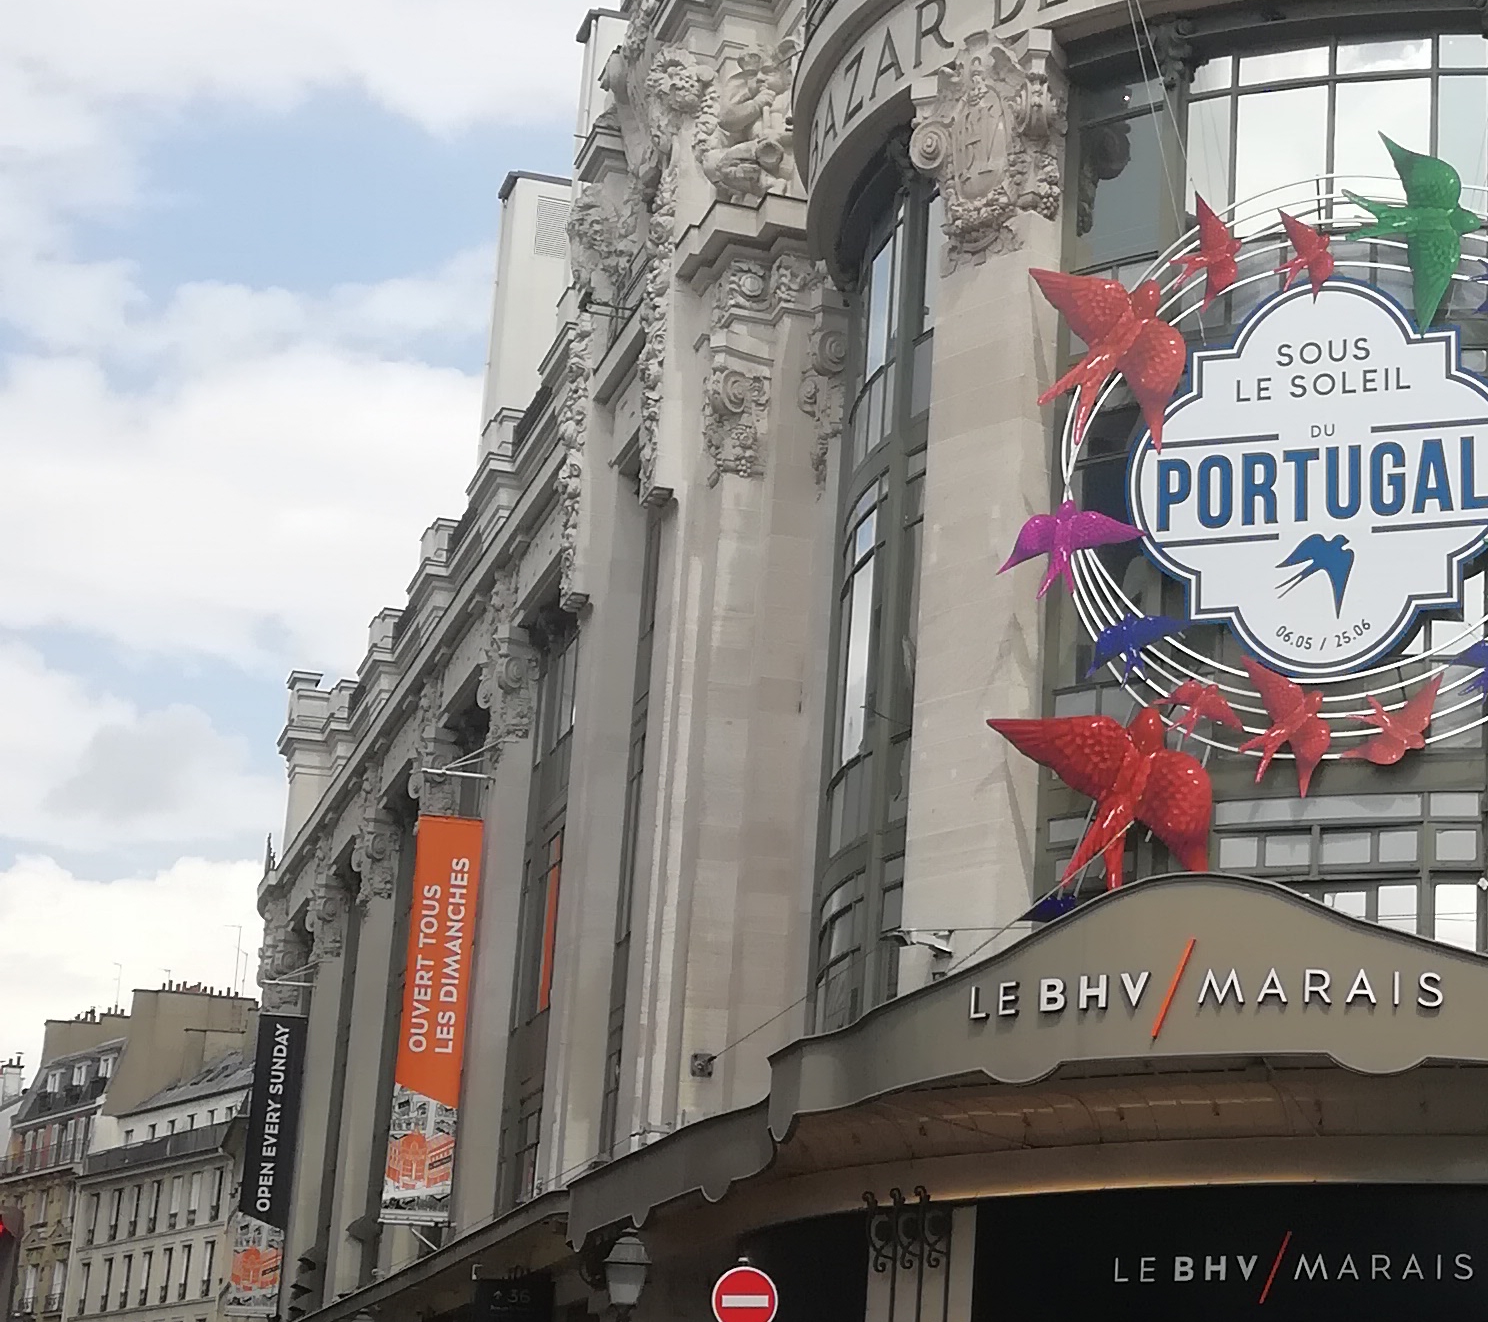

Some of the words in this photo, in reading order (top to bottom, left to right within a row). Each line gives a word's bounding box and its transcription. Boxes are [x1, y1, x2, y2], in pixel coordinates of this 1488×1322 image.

[1276, 337, 1370, 368] SOUS
[1236, 377, 1271, 403] LE
[1290, 367, 1410, 398] SOLEIL
[1310, 424, 1335, 438] DU
[1276, 626, 1312, 650] 06.05
[1335, 619, 1370, 648] 25.06
[419, 883, 441, 950] TOUS
[440, 856, 470, 1004] DIMANCHES
[408, 954, 435, 1054] OUVERT
[969, 981, 1017, 1019] LE
[434, 1009, 455, 1054] LES
[268, 1022, 292, 1098] SUNDAY
[261, 1099, 283, 1158] EVERY
[256, 1163, 275, 1213] OPEN
[1114, 1257, 1156, 1282] LE
